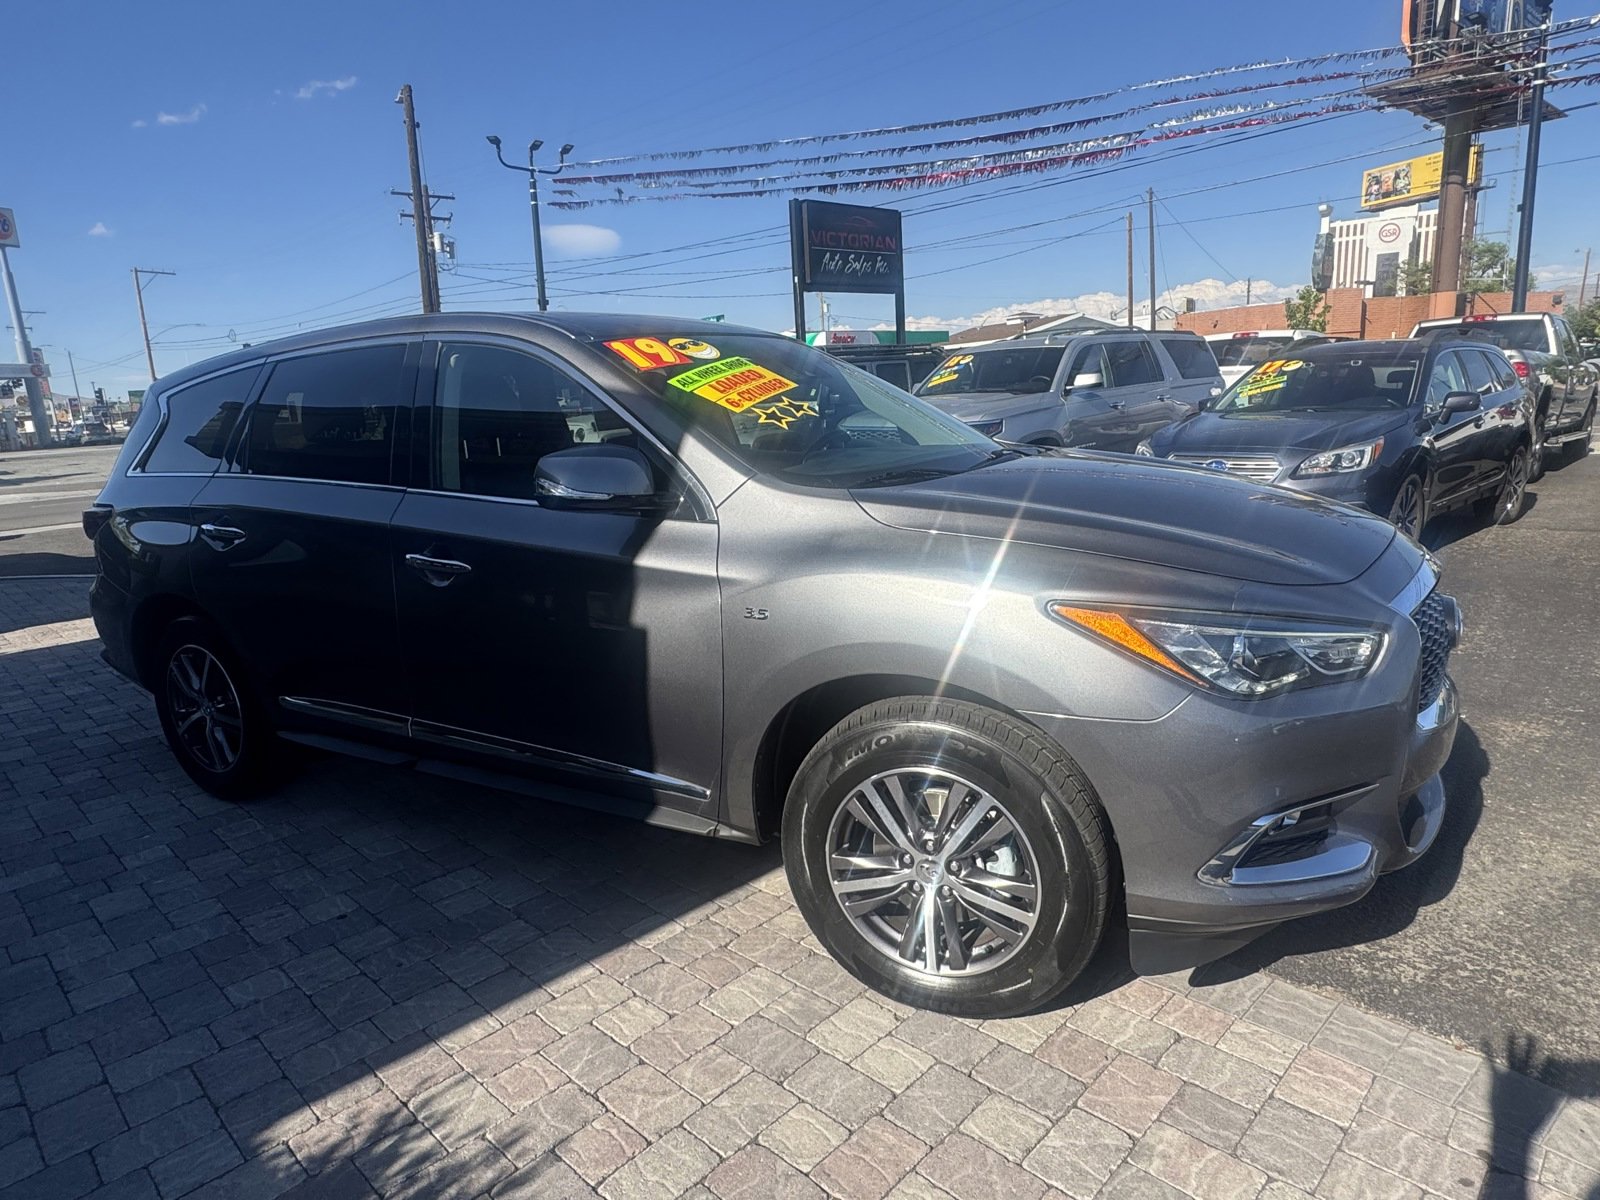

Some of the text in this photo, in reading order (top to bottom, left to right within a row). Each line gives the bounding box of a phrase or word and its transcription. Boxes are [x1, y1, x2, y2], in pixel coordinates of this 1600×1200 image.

[811, 230, 896, 250] VICTORIAN
[1381, 228, 1398, 238] GSR
[821, 252, 842, 274] Auto
[845, 254, 872, 277] Sales
[610, 338, 679, 369] 19
[676, 358, 752, 389] ALL WHEEL DRIVE
[708, 369, 766, 394] LOADED
[725, 378, 792, 409] 6-CYLINDER
[744, 607, 769, 620] 3.5
